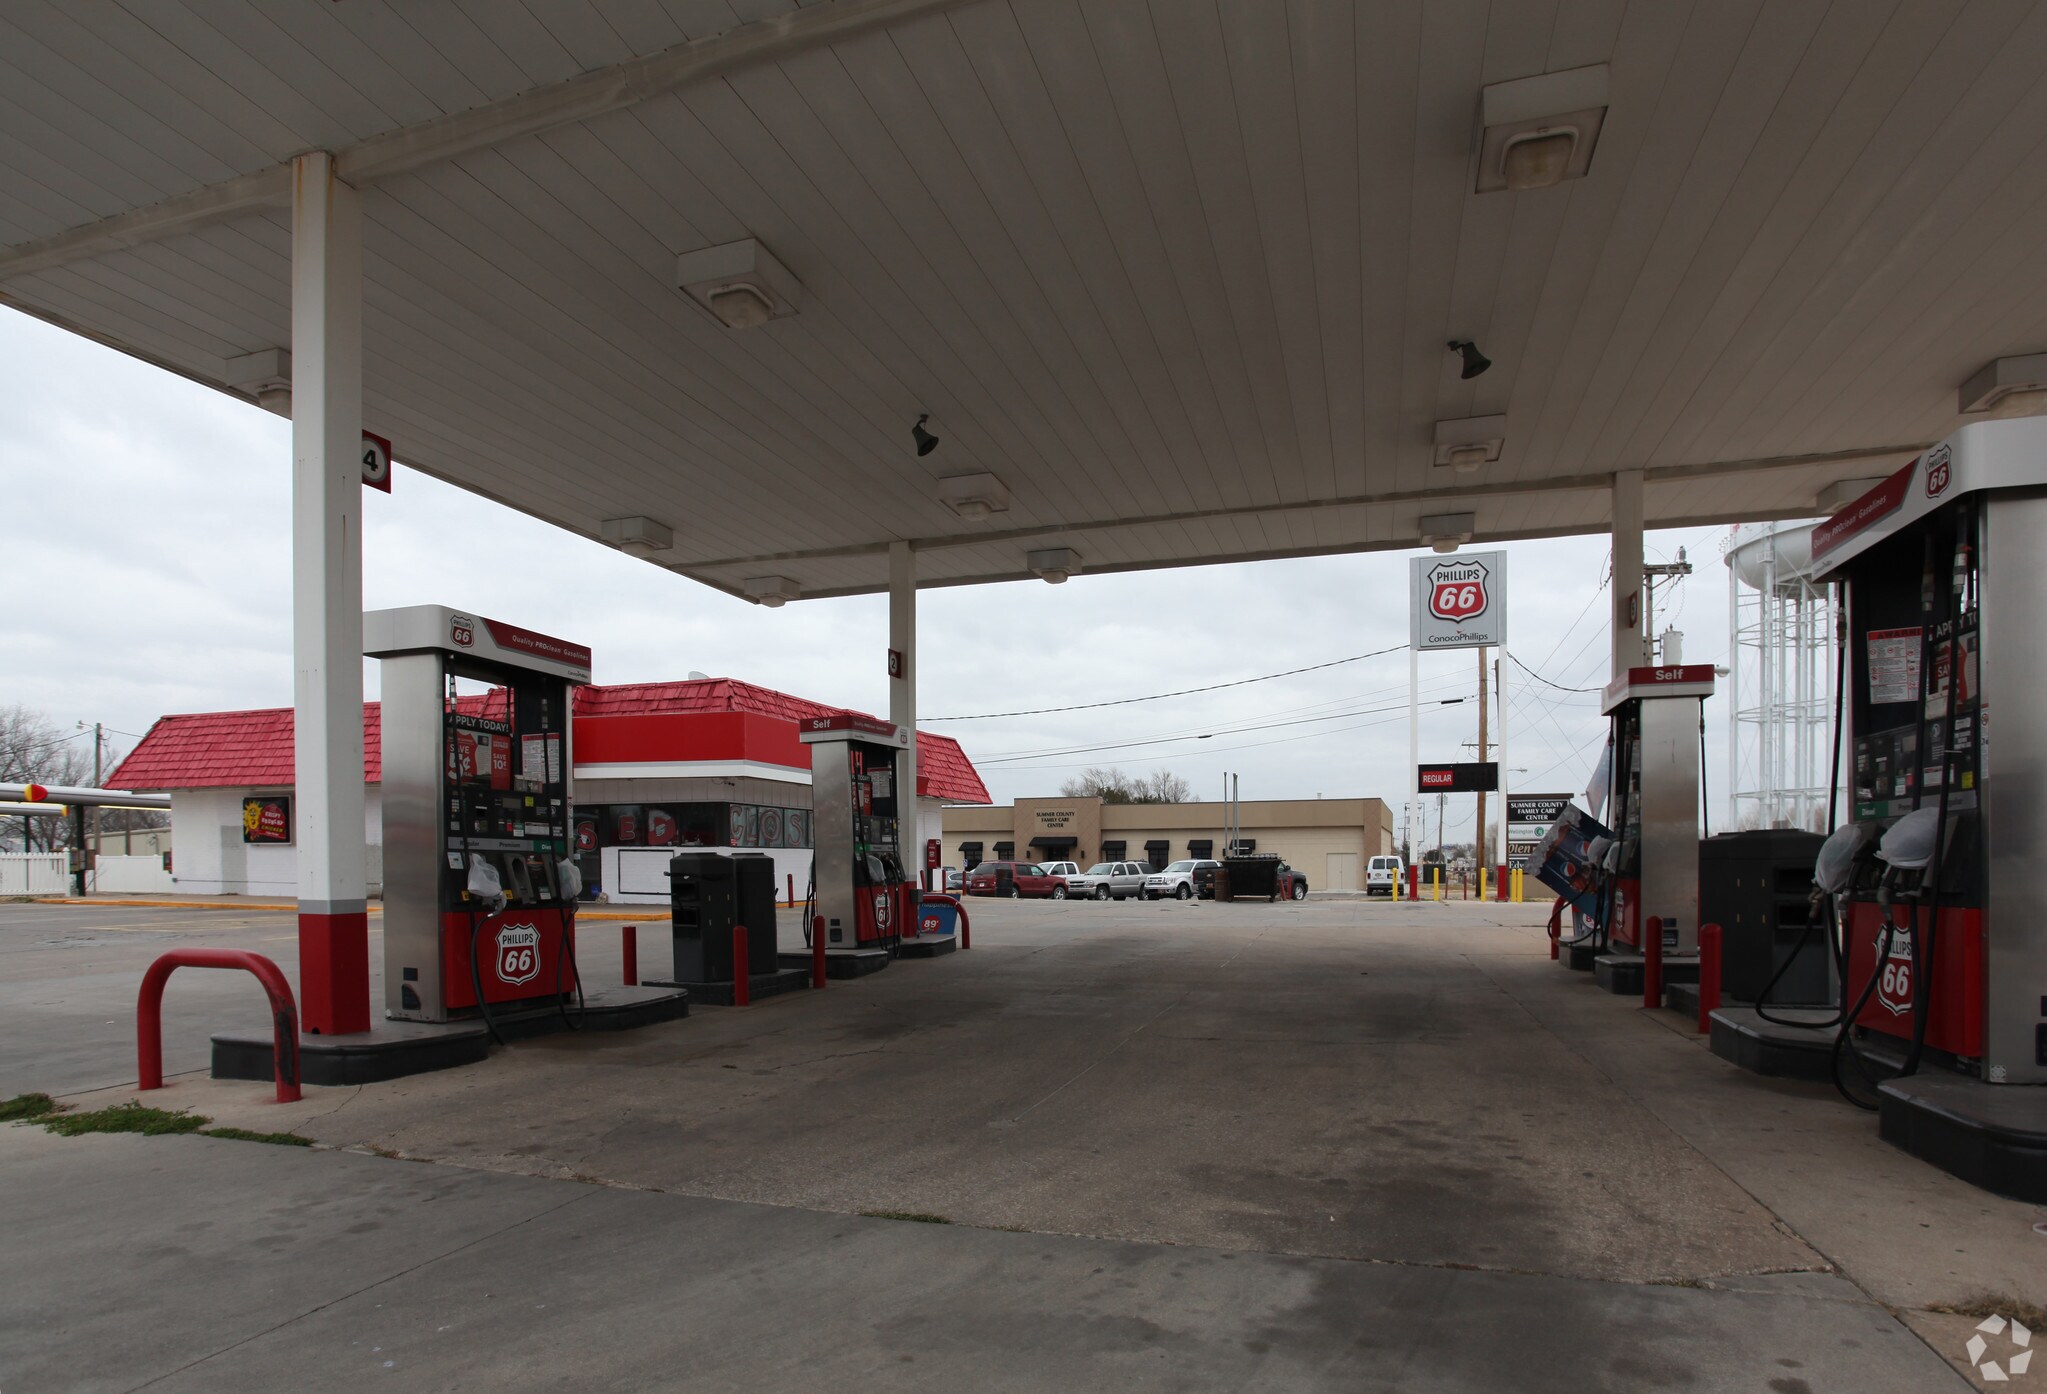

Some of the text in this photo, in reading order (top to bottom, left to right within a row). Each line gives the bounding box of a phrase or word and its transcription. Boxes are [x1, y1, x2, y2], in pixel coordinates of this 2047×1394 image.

[363, 449, 379, 472] 4
[1928, 451, 1948, 469] PHILLIPS
[1929, 466, 1947, 491] 66
[1436, 569, 1480, 582] PHILLIPS
[1439, 586, 1477, 610] 66
[453, 619, 471, 630] PHILLIPS
[454, 629, 470, 643] 66
[1428, 632, 1489, 643] ConocoPhillips
[512, 634, 535, 648] Quality
[563, 648, 589, 661] Gasolines
[891, 658, 896, 669] 2
[1655, 668, 1684, 681] Self
[479, 718, 509, 733] TODAY!
[812, 719, 831, 729] Self
[493, 753, 507, 761] SAVE
[1423, 774, 1452, 783] REGULAR
[1508, 844, 1531, 854] Olen
[502, 933, 534, 945] PHILLIPS
[504, 949, 532, 973] 66
[1882, 963, 1910, 996] 66
